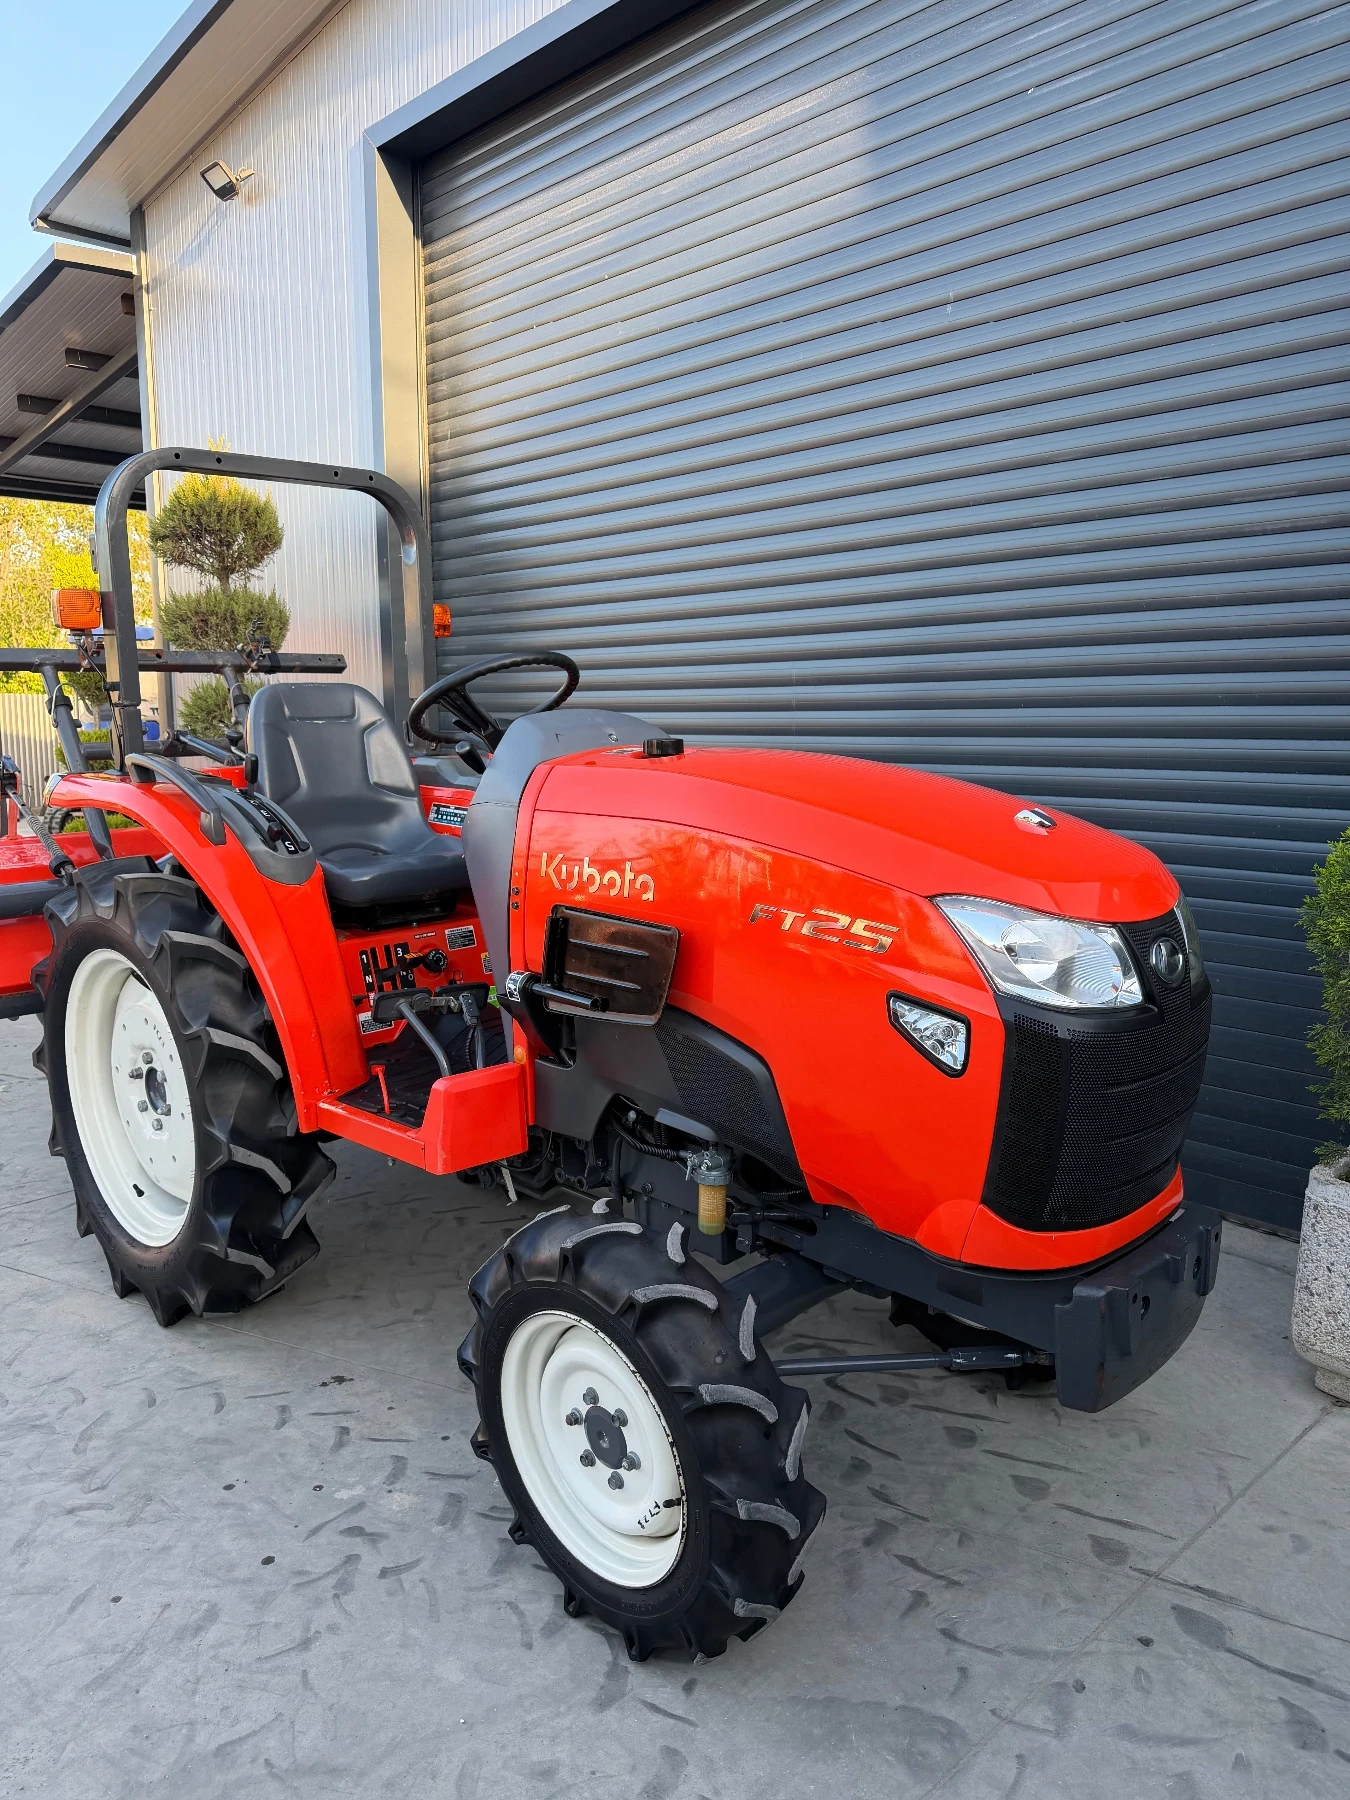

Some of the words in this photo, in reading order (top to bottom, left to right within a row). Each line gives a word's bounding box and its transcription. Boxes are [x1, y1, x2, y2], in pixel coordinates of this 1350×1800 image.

[540, 851, 656, 902] Kubota
[749, 903, 900, 954] FT25
[396, 947, 403, 957] 3
[361, 954, 368, 964] 1
[365, 974, 373, 984] N
